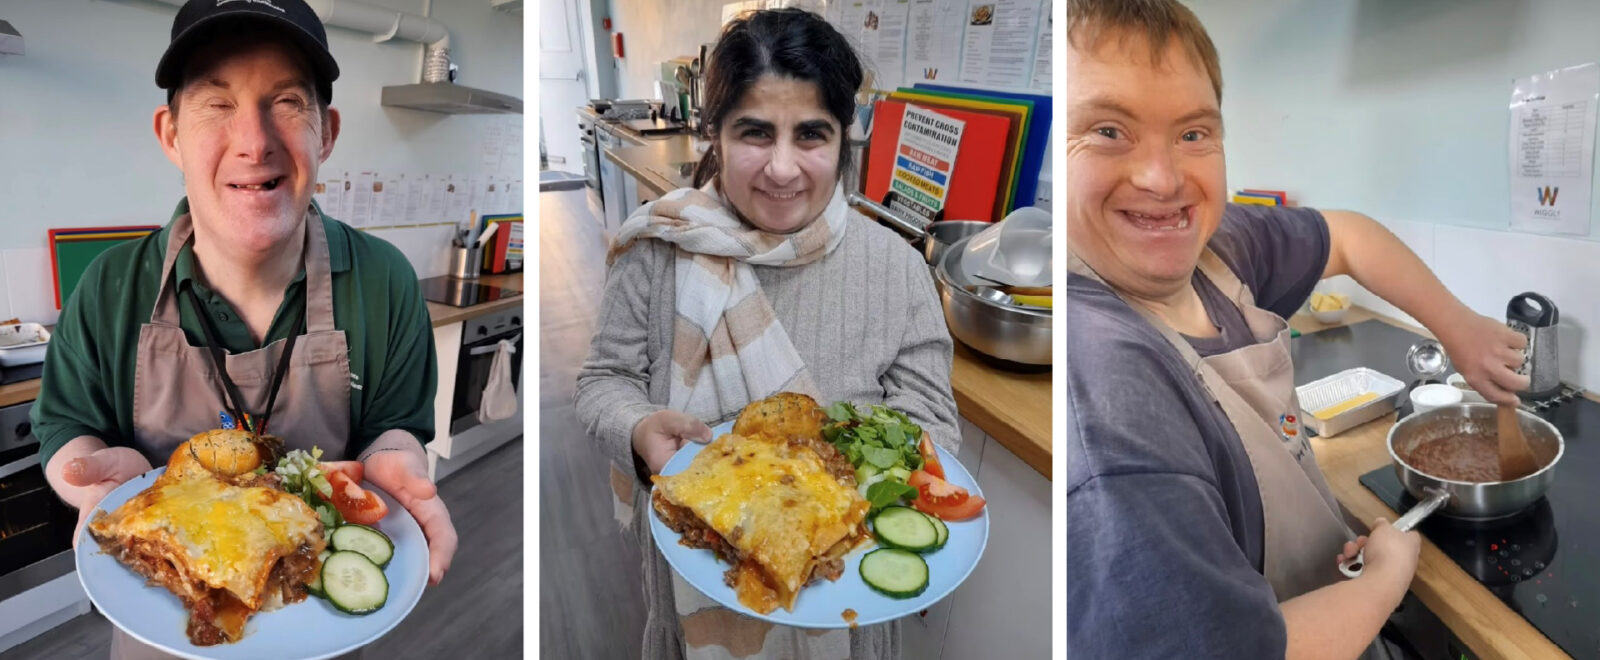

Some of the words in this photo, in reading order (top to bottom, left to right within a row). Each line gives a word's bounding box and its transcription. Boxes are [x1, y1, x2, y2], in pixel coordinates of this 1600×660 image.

[904, 120, 958, 147] CONTAMINATION
[906, 110, 934, 126] PREVENT
[935, 120, 959, 135] CROSS
[909, 149, 922, 160] RAW
[922, 155, 939, 167] MEAT
[898, 170, 920, 186] COOKED
[920, 180, 940, 195] MEATS
[920, 167, 935, 179] FISH
[895, 180, 914, 197] SALADS
[919, 193, 938, 209] FRUITS
[897, 195, 931, 217] VEGETABLES
